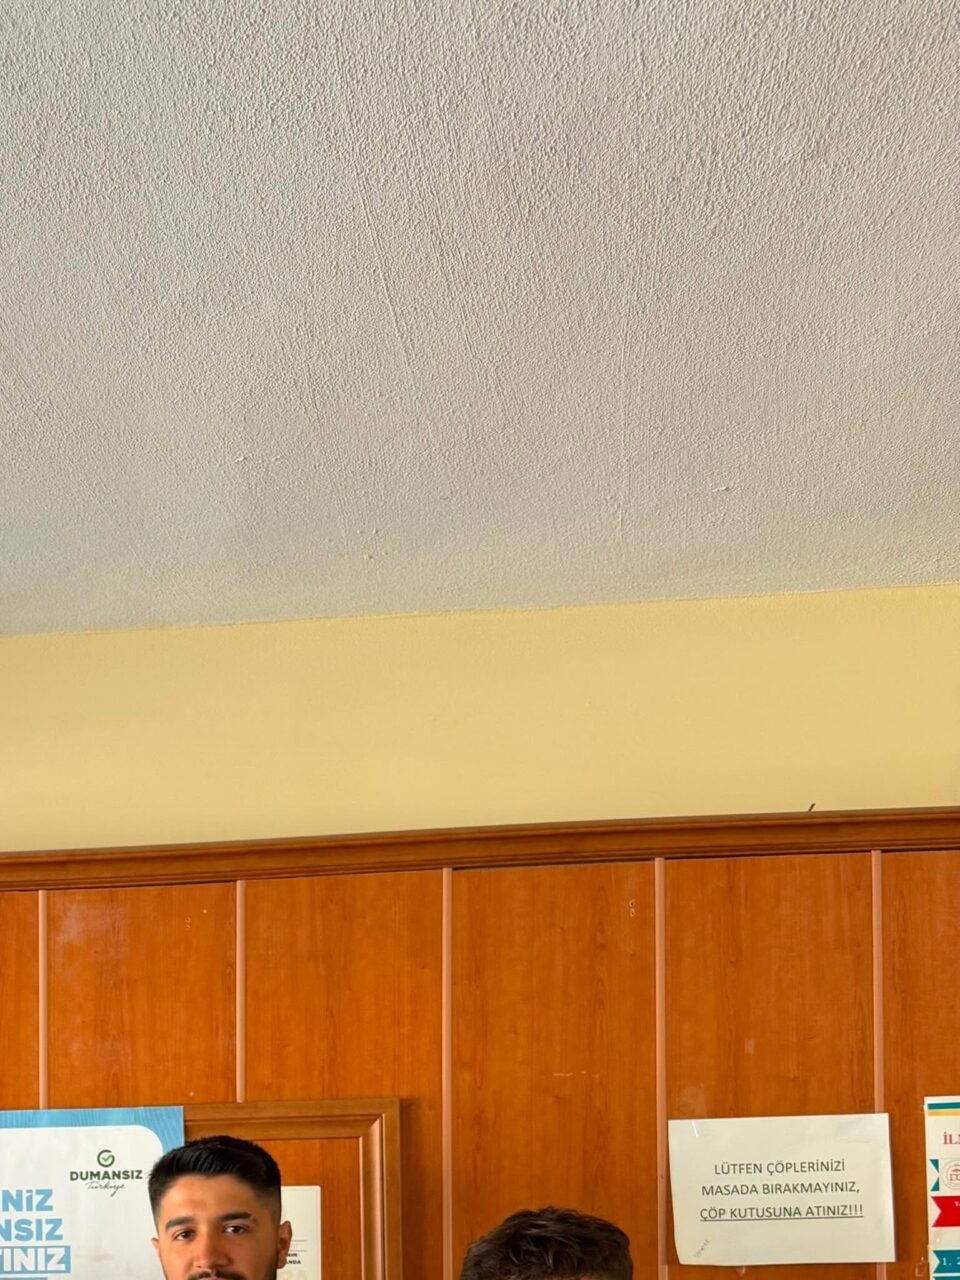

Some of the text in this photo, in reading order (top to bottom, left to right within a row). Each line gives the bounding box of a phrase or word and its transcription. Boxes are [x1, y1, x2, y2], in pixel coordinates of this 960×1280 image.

[70, 1169, 143, 1181] DUMANSIZ
[714, 1158, 845, 1176] LÜTFEN ÇÖPLERİNİZİ
[702, 1181, 860, 1196] MASADA BIRAKMAYINIZ,
[700, 1204, 863, 1221] ÇÖP KUTUSUNA ATINIZ!!!
